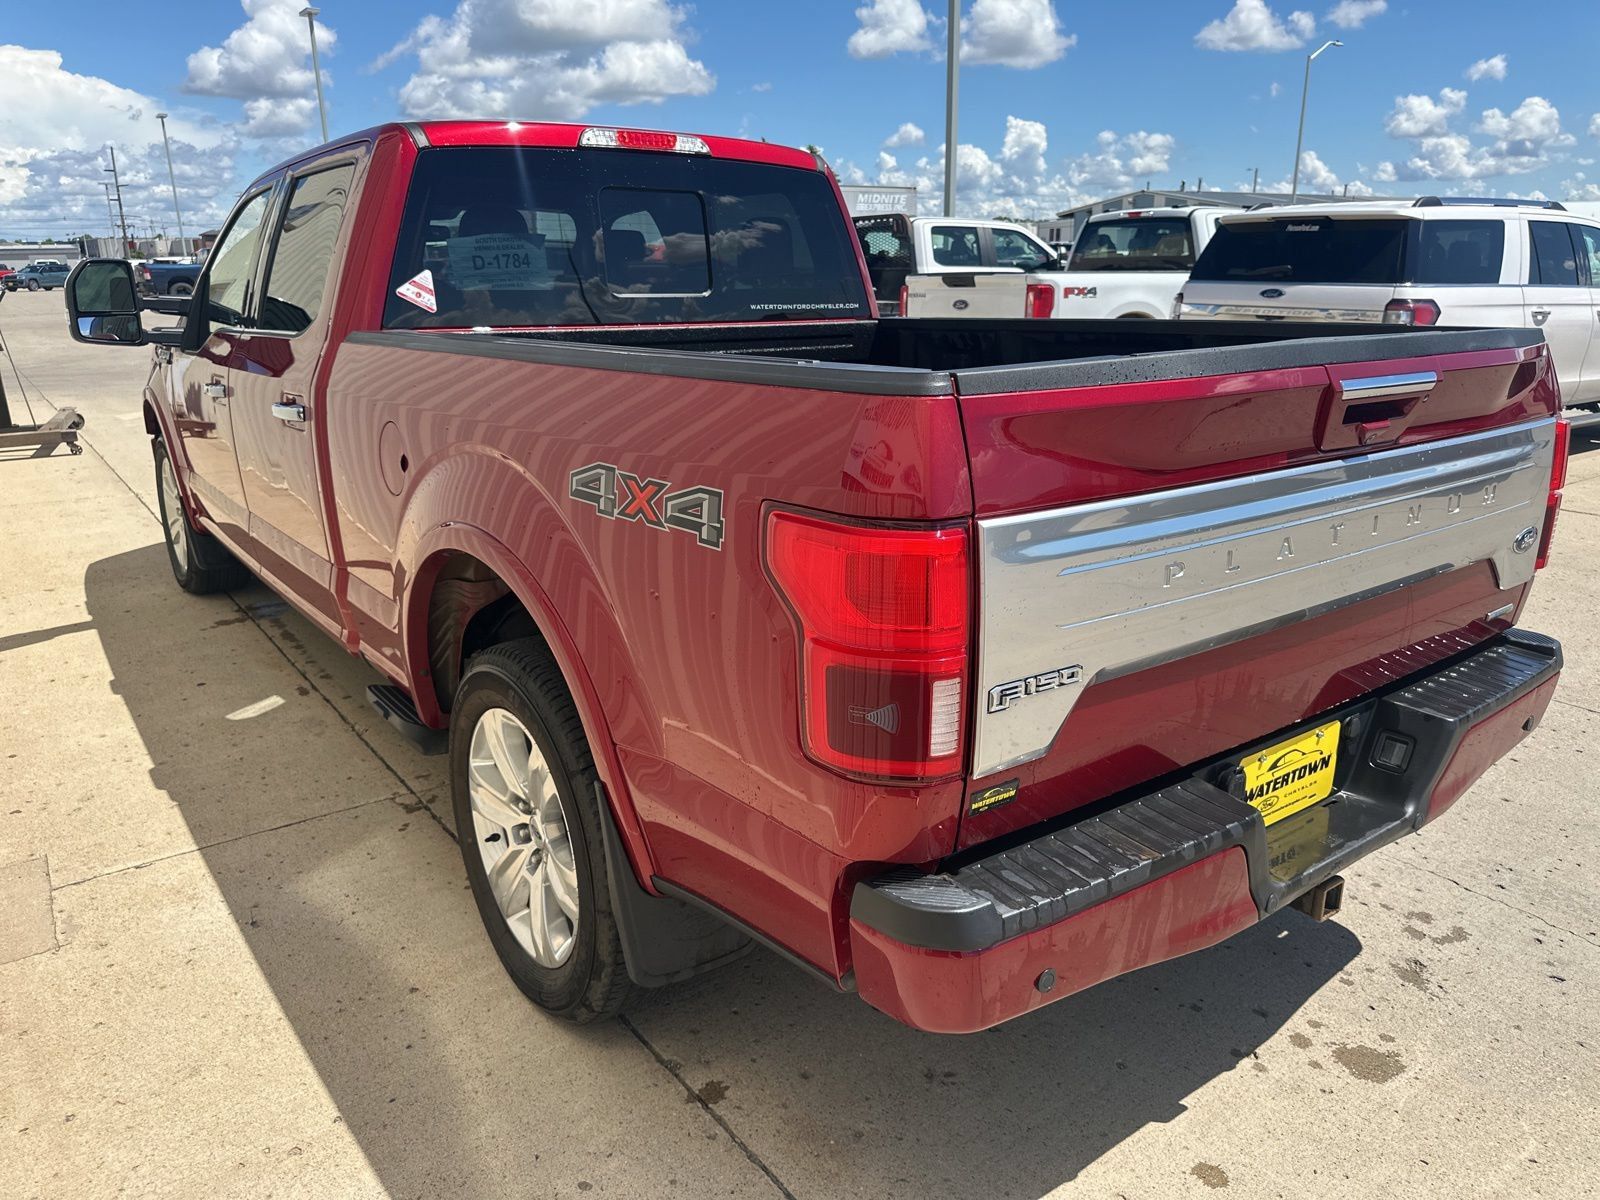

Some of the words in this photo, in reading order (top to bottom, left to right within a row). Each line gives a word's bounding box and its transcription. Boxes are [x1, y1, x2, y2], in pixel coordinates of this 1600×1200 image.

[857, 193, 907, 204] MIDNITE
[472, 252, 531, 271] D-1784
[1063, 286, 1097, 299] FX4
[1162, 483, 1498, 588] PLATINUM
[1245, 753, 1332, 803] WATERTOWN
[971, 788, 1016, 811] WATERTOWN
